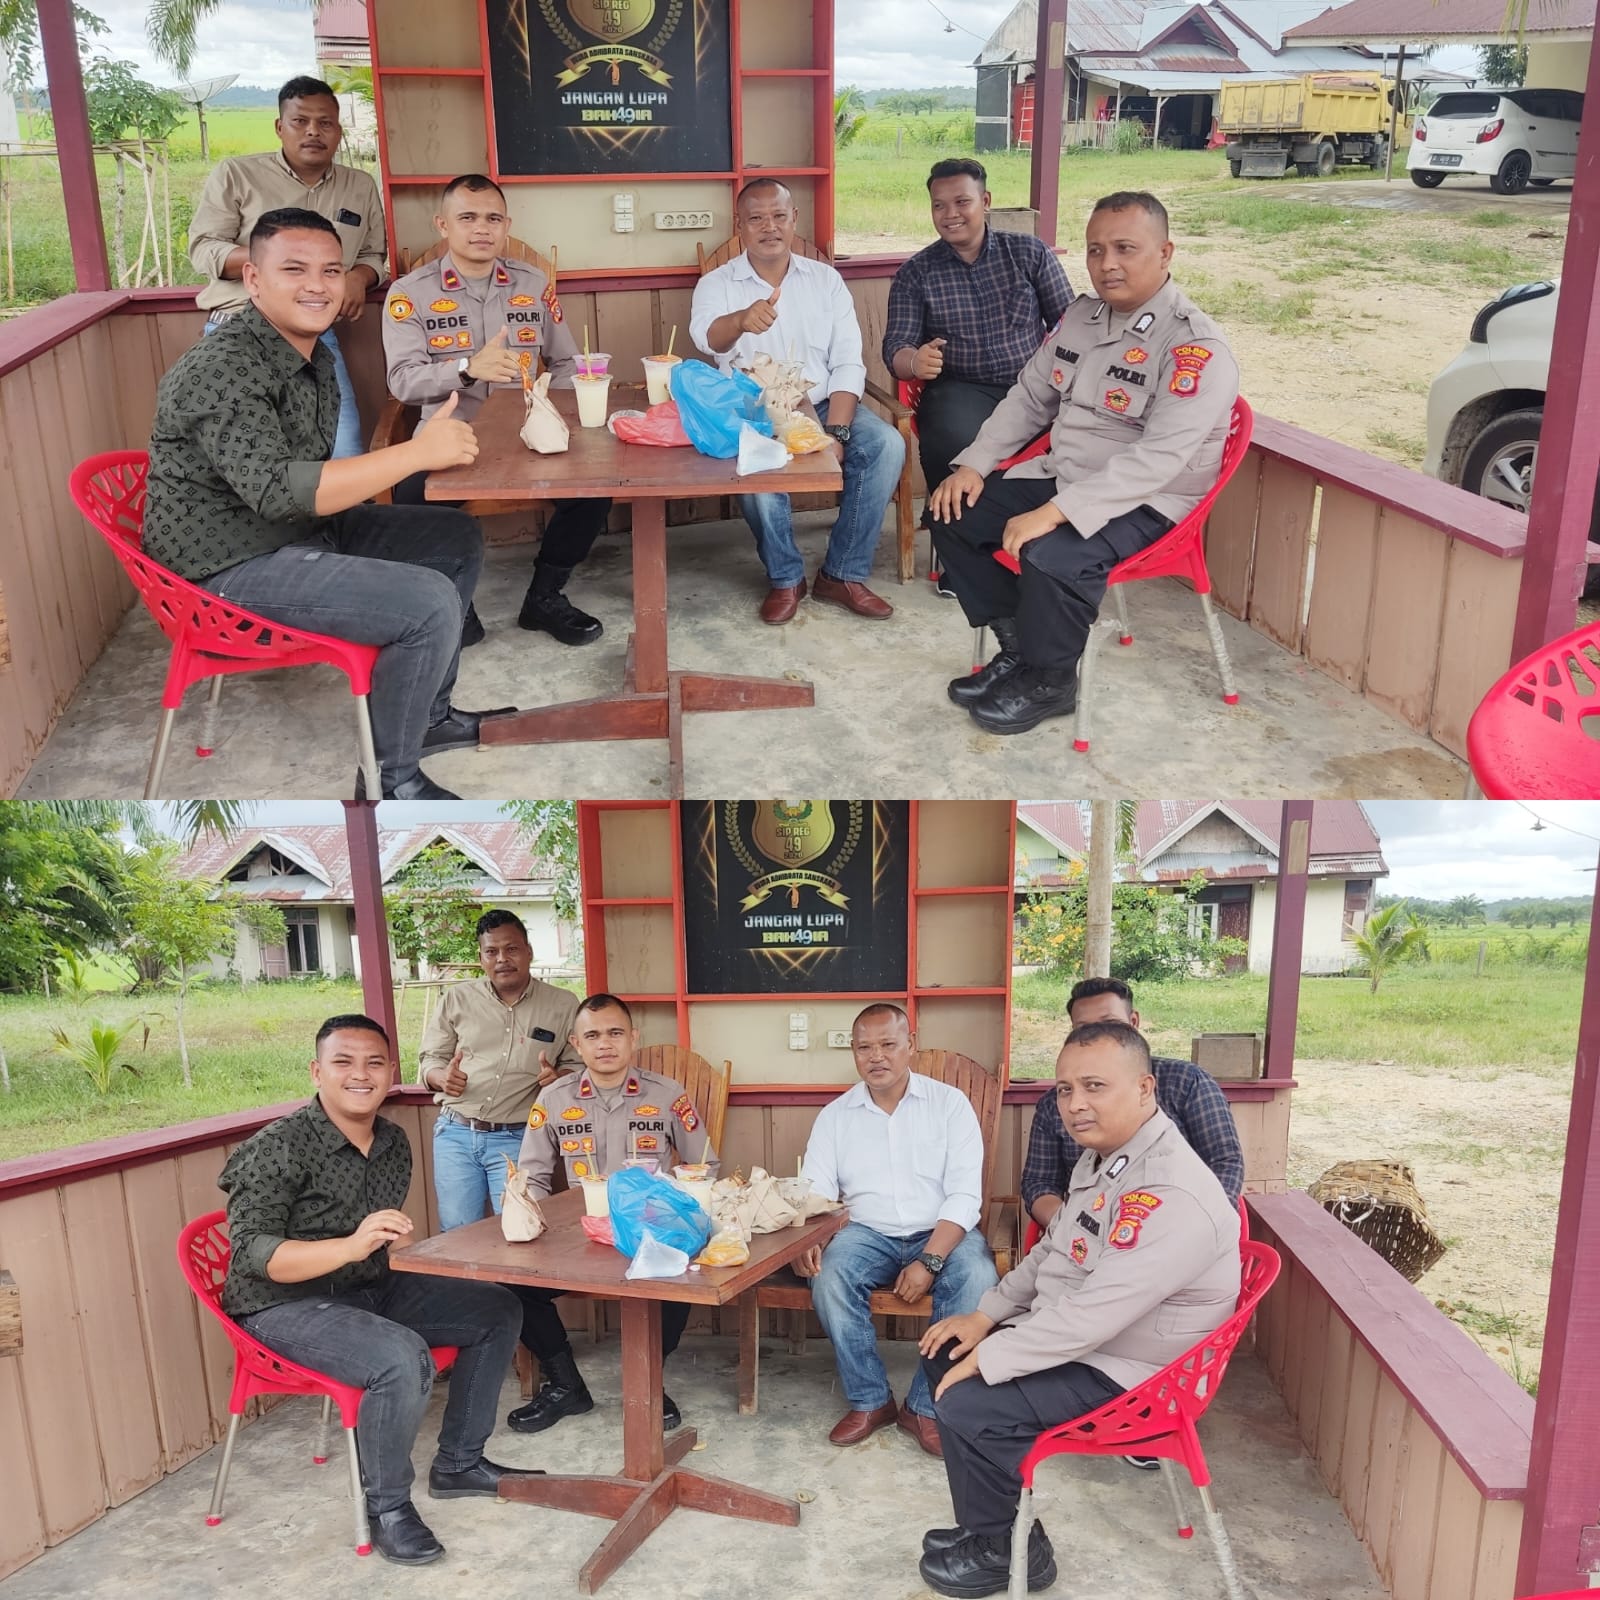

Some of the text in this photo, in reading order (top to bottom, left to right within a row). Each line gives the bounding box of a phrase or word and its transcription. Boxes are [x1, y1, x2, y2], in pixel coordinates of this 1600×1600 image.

[603, 10, 621, 26] 49
[562, 92, 668, 105] JANGAN LUPA
[426, 315, 469, 331] DEDE
[507, 311, 541, 324] POLRI
[1106, 365, 1147, 387] POLRI
[785, 837, 802, 852] 49
[745, 914, 844, 928] JANGAN LUPA
[558, 1123, 593, 1136] DEDE
[629, 1121, 664, 1132] POLRI
